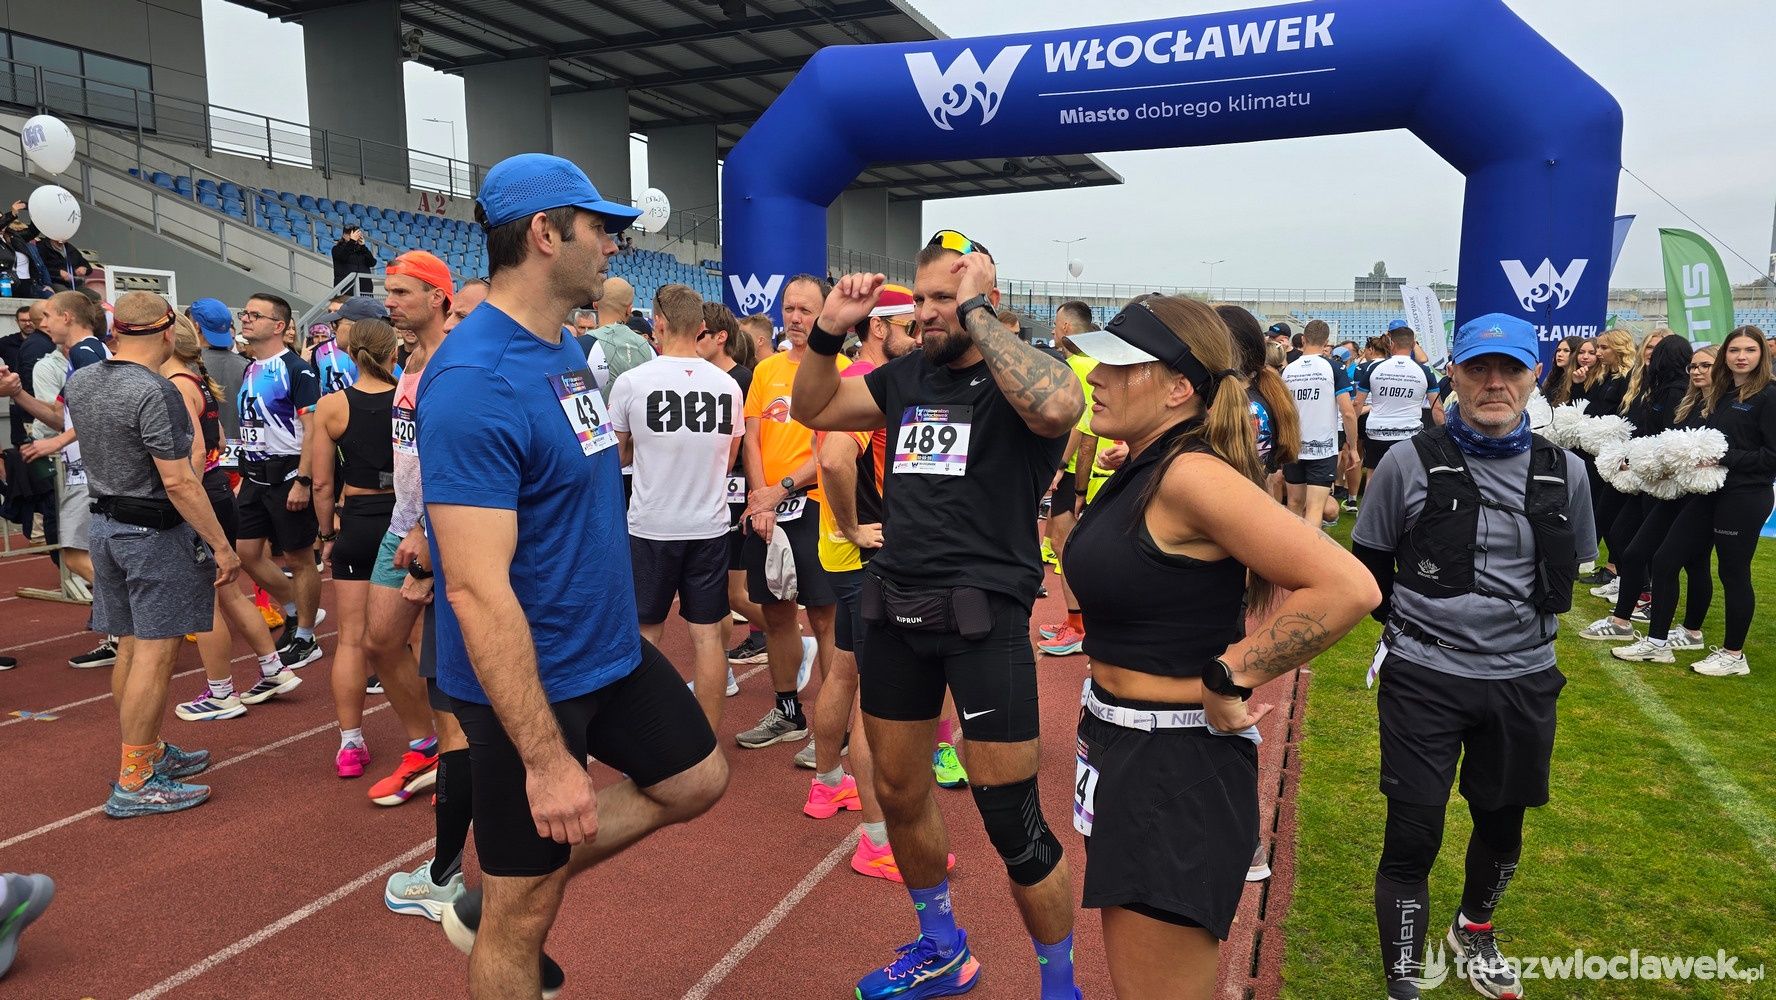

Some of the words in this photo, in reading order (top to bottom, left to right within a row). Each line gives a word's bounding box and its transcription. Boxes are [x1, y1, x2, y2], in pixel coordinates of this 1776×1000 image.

[1043, 12, 1336, 74] WŁOCŁAWEK
[1060, 106, 1130, 126] Miasto
[1135, 99, 1222, 121] dobrego
[1228, 92, 1311, 114] klimatu
[1297, 388, 1320, 401] 097.5
[1379, 386, 1388, 397] 21
[1389, 386, 1413, 399] 097.5
[575, 394, 600, 429] 43
[646, 390, 734, 436] 001
[394, 420, 415, 442] 420
[903, 424, 958, 454] 489
[896, 615, 923, 624] KIPRUN
[1090, 701, 1115, 721] NIKE
[1171, 712, 1208, 726] NIK
[404, 884, 430, 896] HOKA
